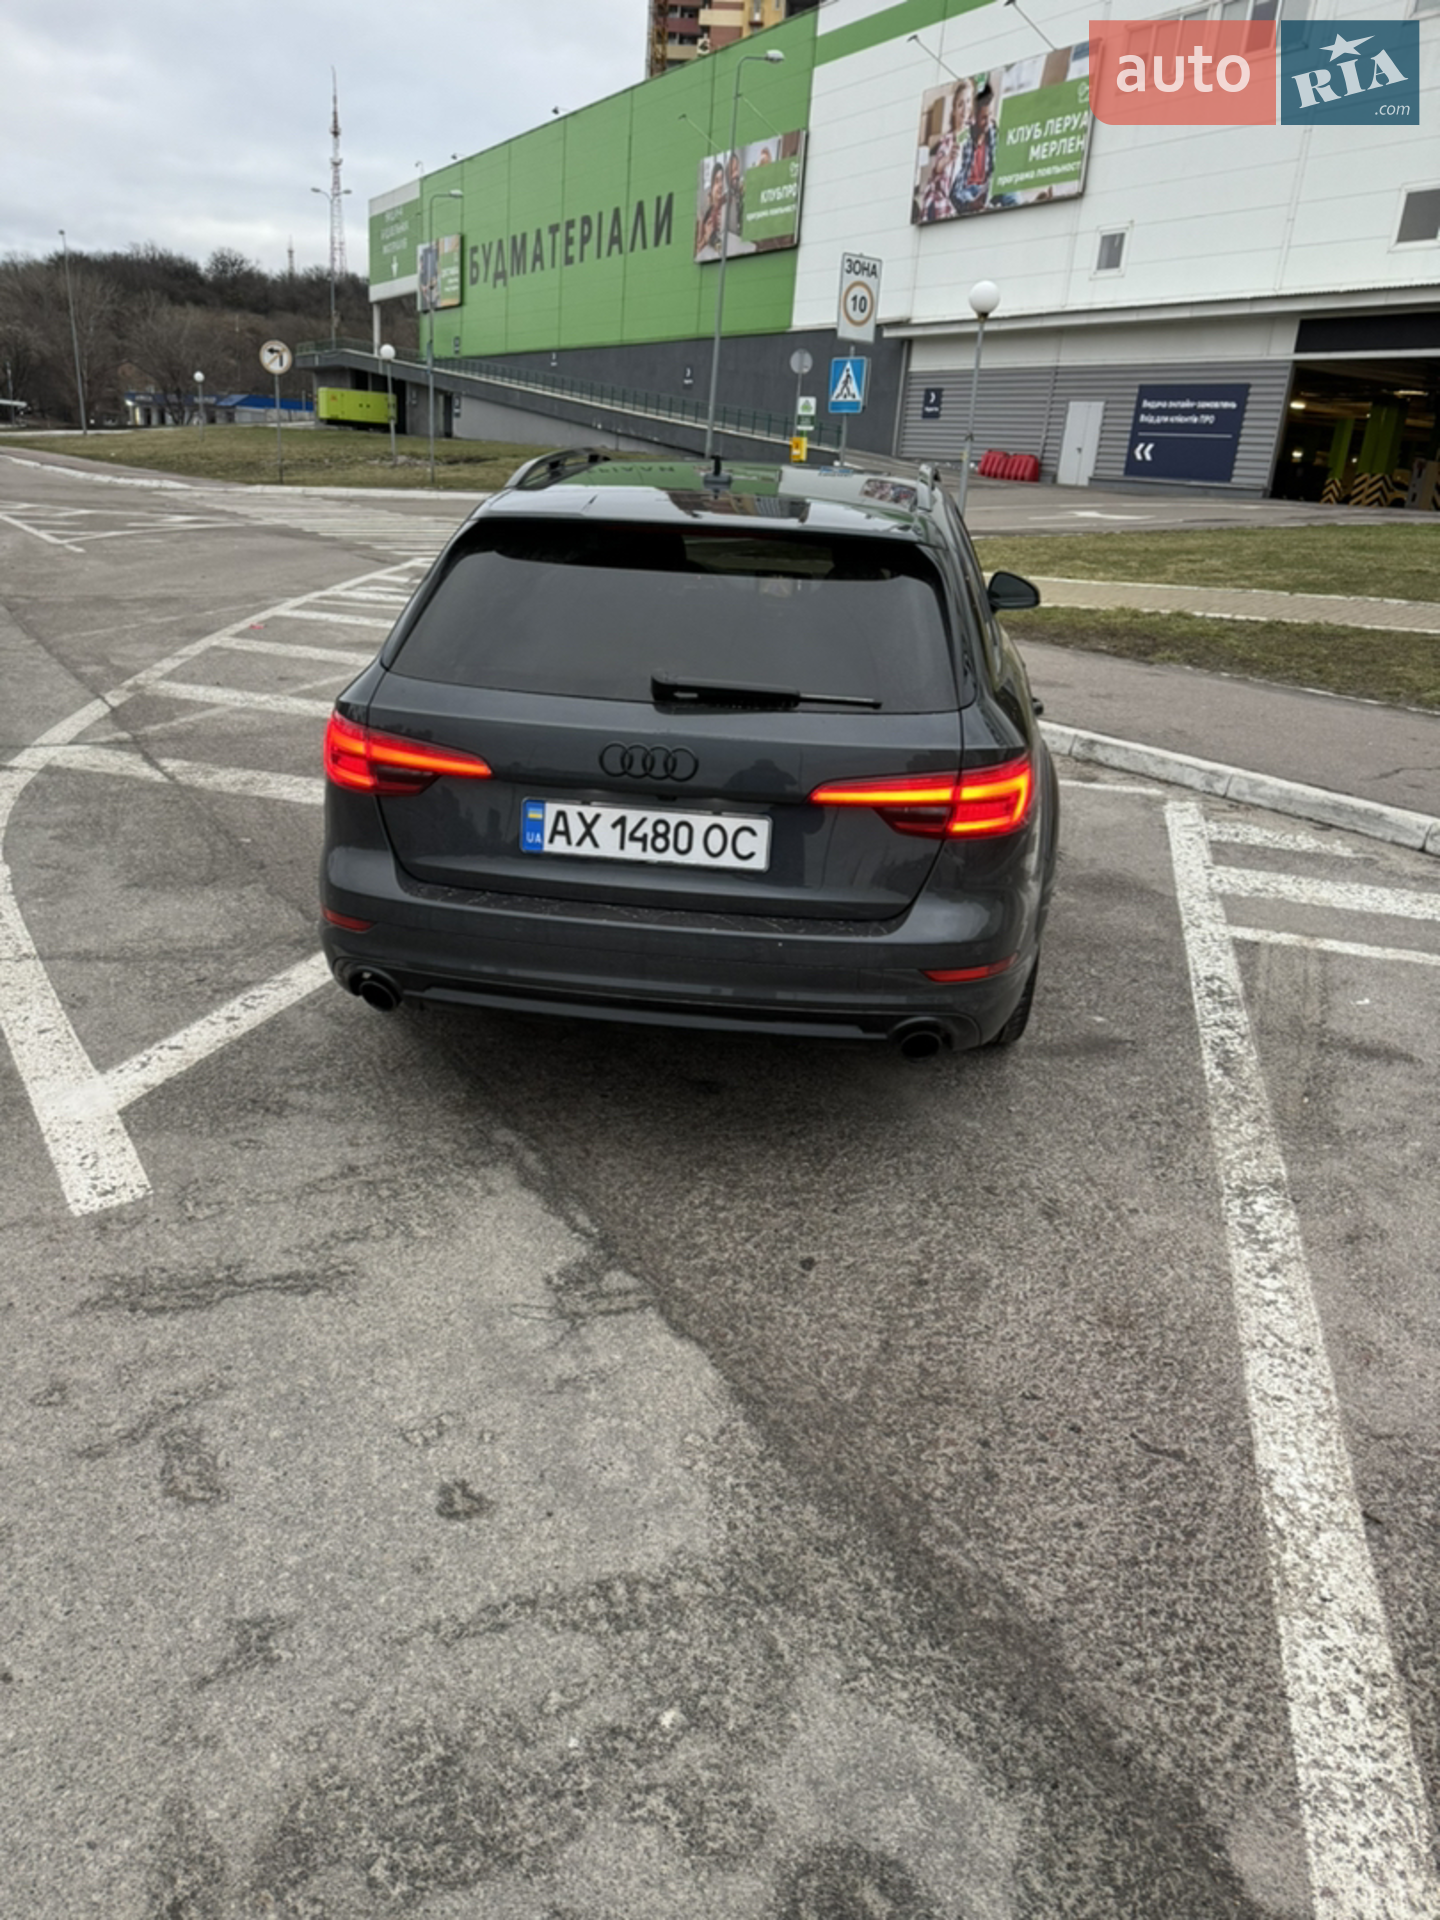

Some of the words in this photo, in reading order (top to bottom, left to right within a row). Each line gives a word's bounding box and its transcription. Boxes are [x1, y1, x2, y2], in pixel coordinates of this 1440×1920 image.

[1006, 122, 1042, 146] КЛУБ
[1043, 110, 1088, 138] ЛЕРУА
[1029, 134, 1085, 162] МЕРЛЕН
[469, 191, 674, 289] БУДМАТЕРІАЛИ
[845, 258, 878, 279] ЗОНА
[851, 294, 868, 313] 10
[526, 832, 542, 844] UA
[548, 810, 602, 849] AX
[611, 814, 694, 856] 1480
[703, 823, 758, 861] OC
